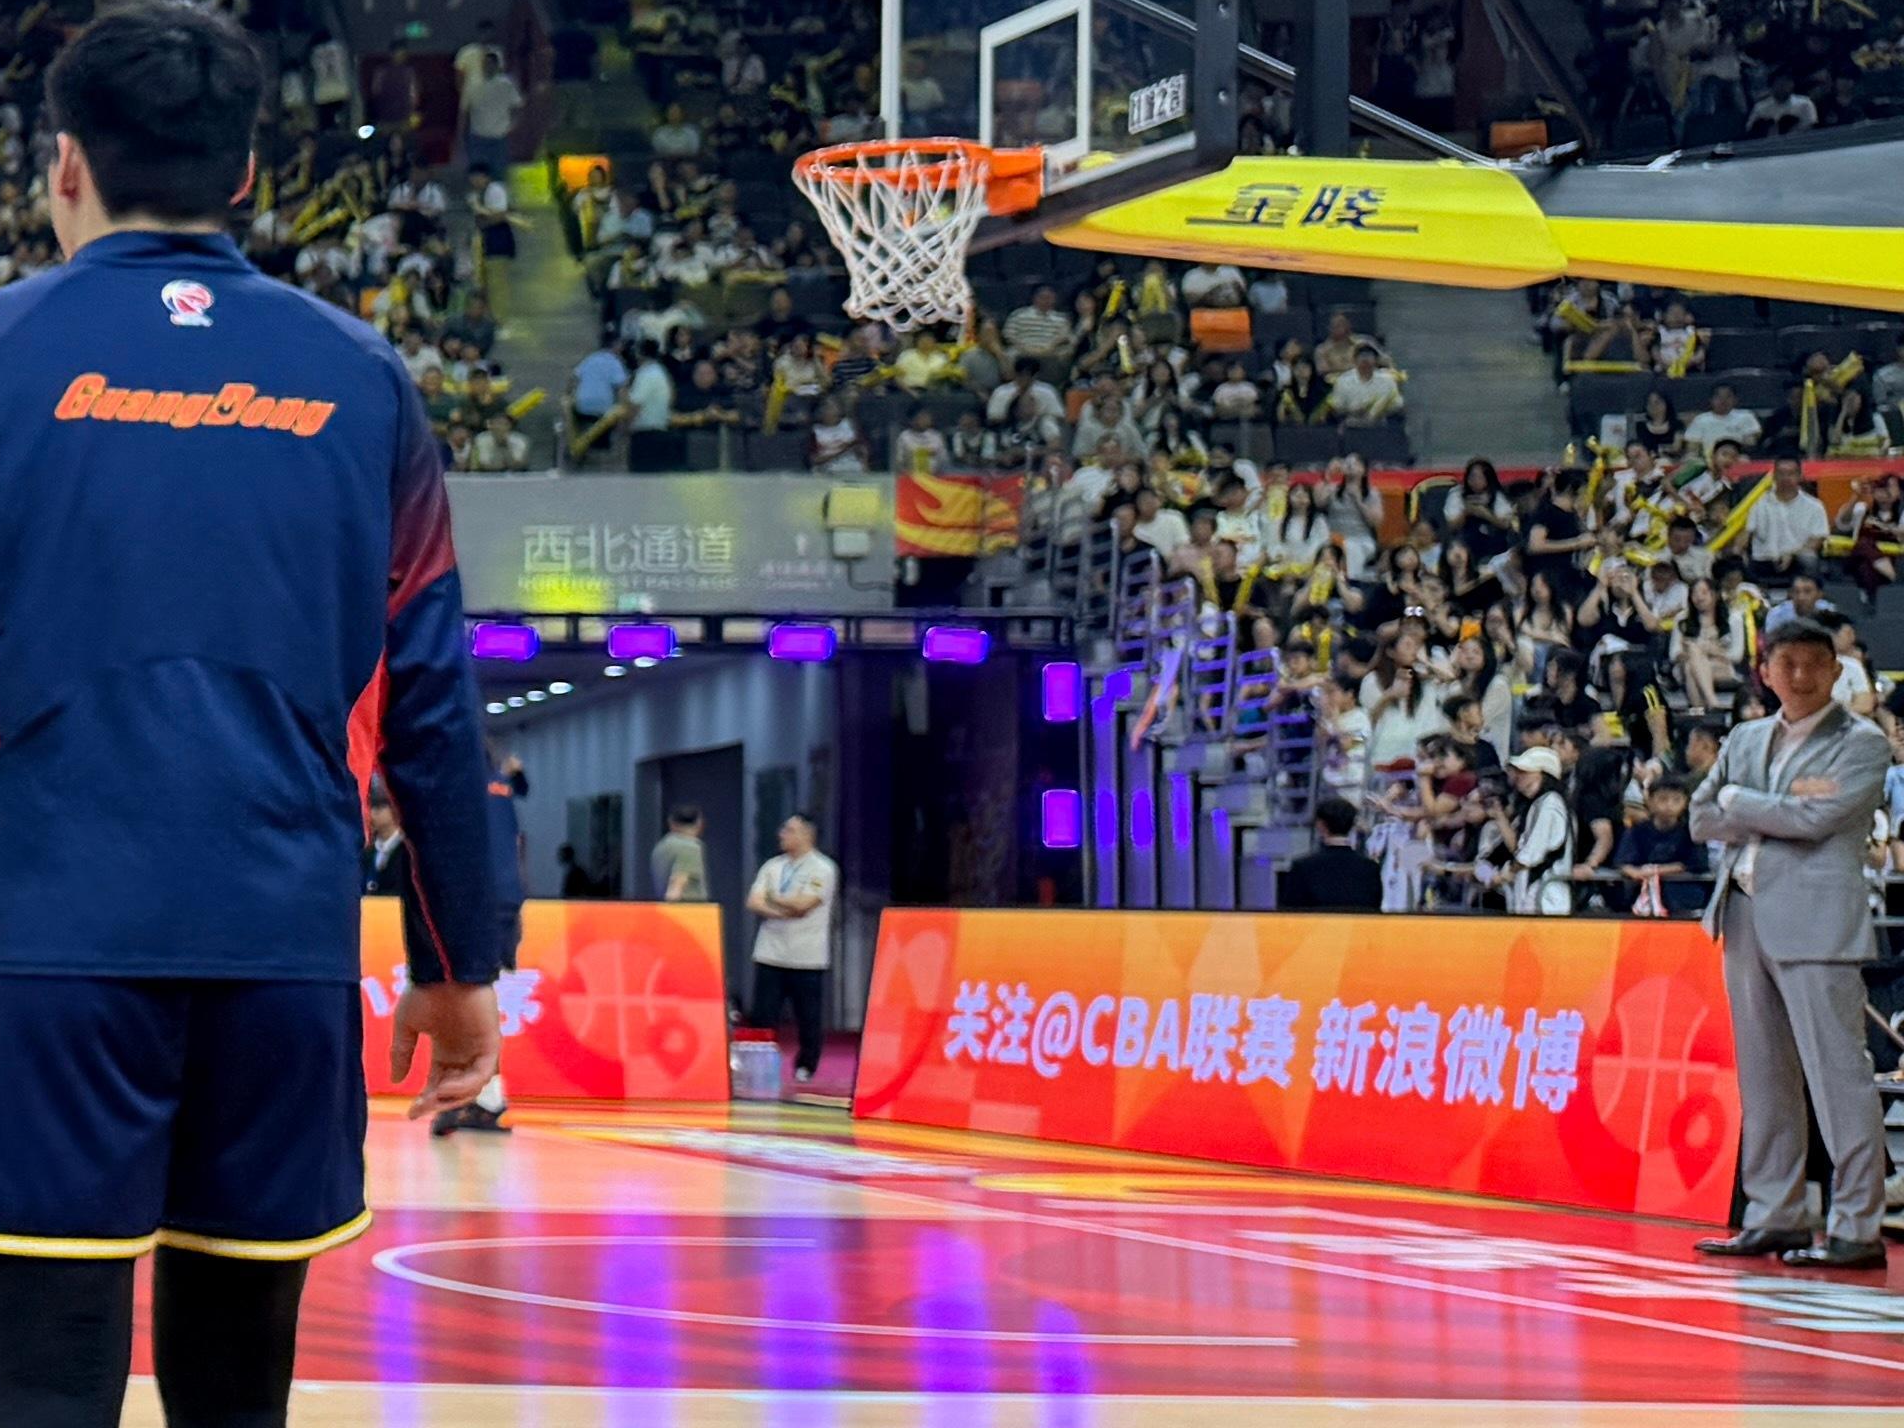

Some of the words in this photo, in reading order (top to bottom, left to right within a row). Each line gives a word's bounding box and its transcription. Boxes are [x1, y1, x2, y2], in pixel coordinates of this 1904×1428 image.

[522, 523, 738, 573] 西北通道
[943, 981, 1300, 1089] 关注@CBA联赛
[1311, 997, 1586, 1113] 新浪微博
